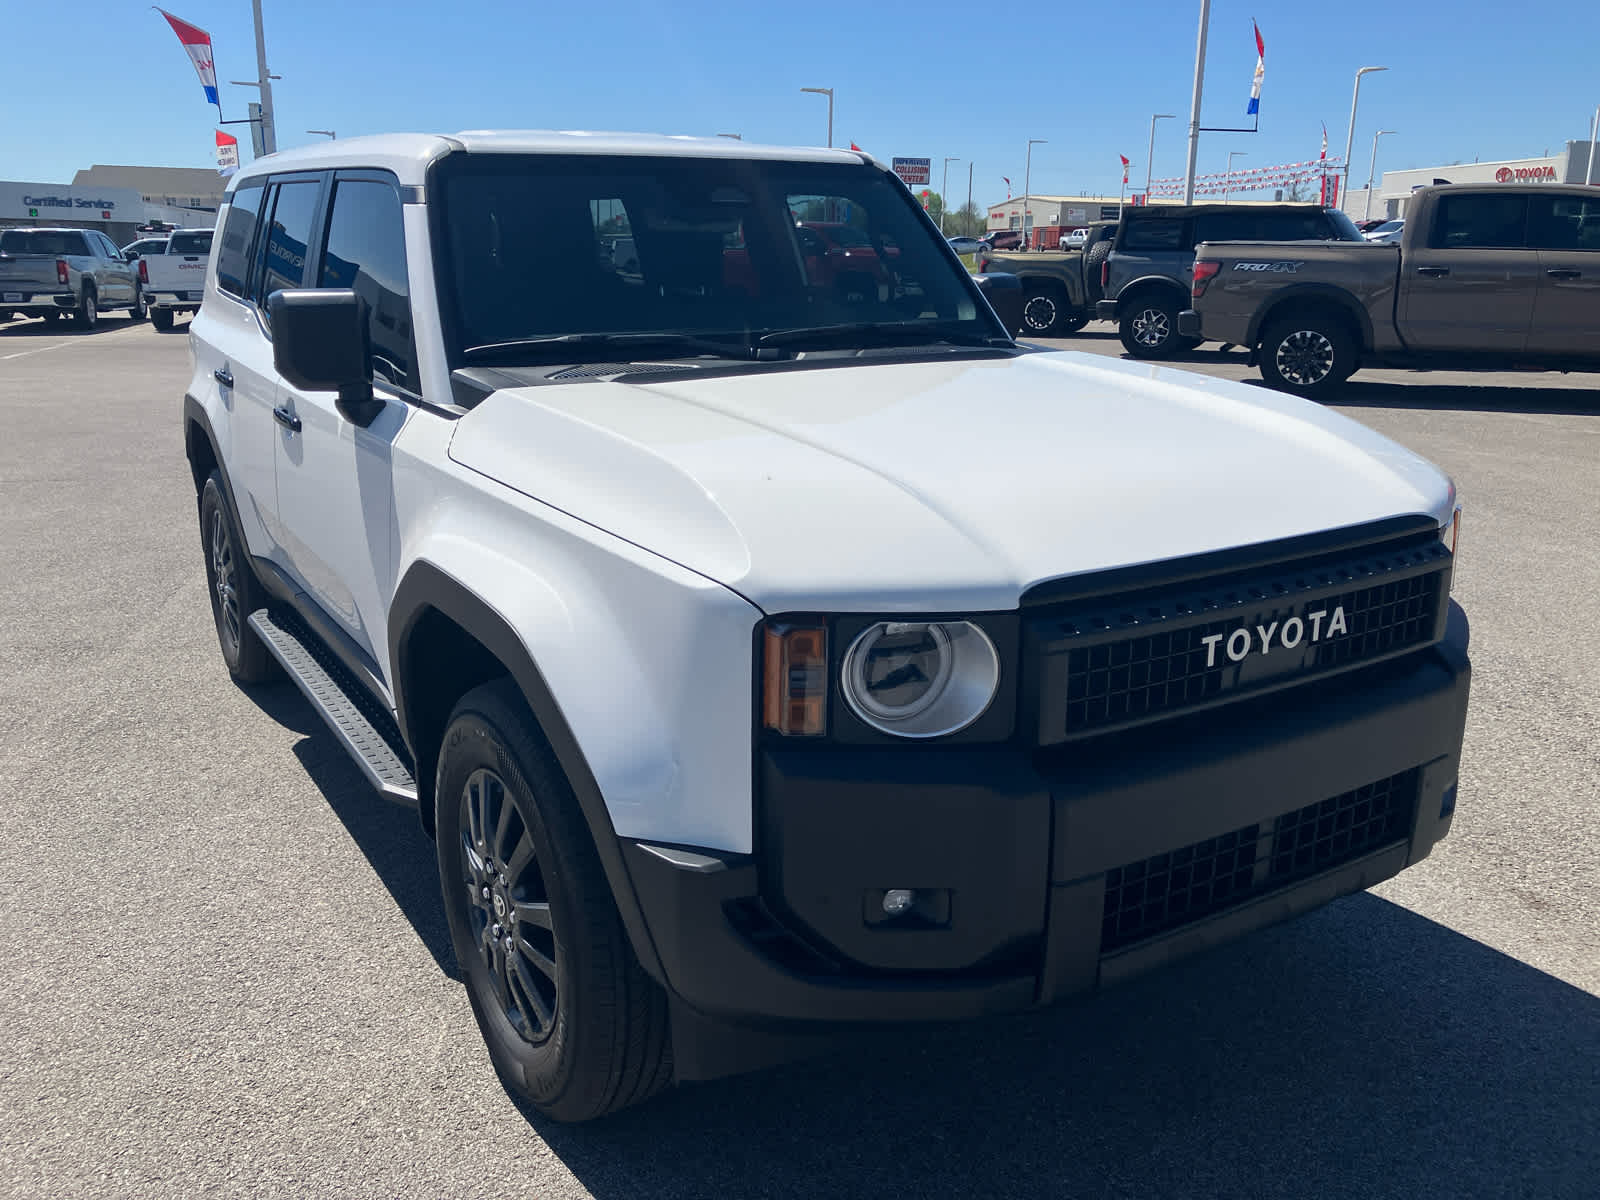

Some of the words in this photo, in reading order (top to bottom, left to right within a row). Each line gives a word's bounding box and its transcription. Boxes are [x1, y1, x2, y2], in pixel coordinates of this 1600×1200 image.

[895, 166, 928, 174] COLLISION
[1514, 166, 1555, 178] TOYOTA
[24, 196, 72, 207] Certified
[74, 198, 114, 209] Service
[1201, 606, 1348, 667] TOYOTA
